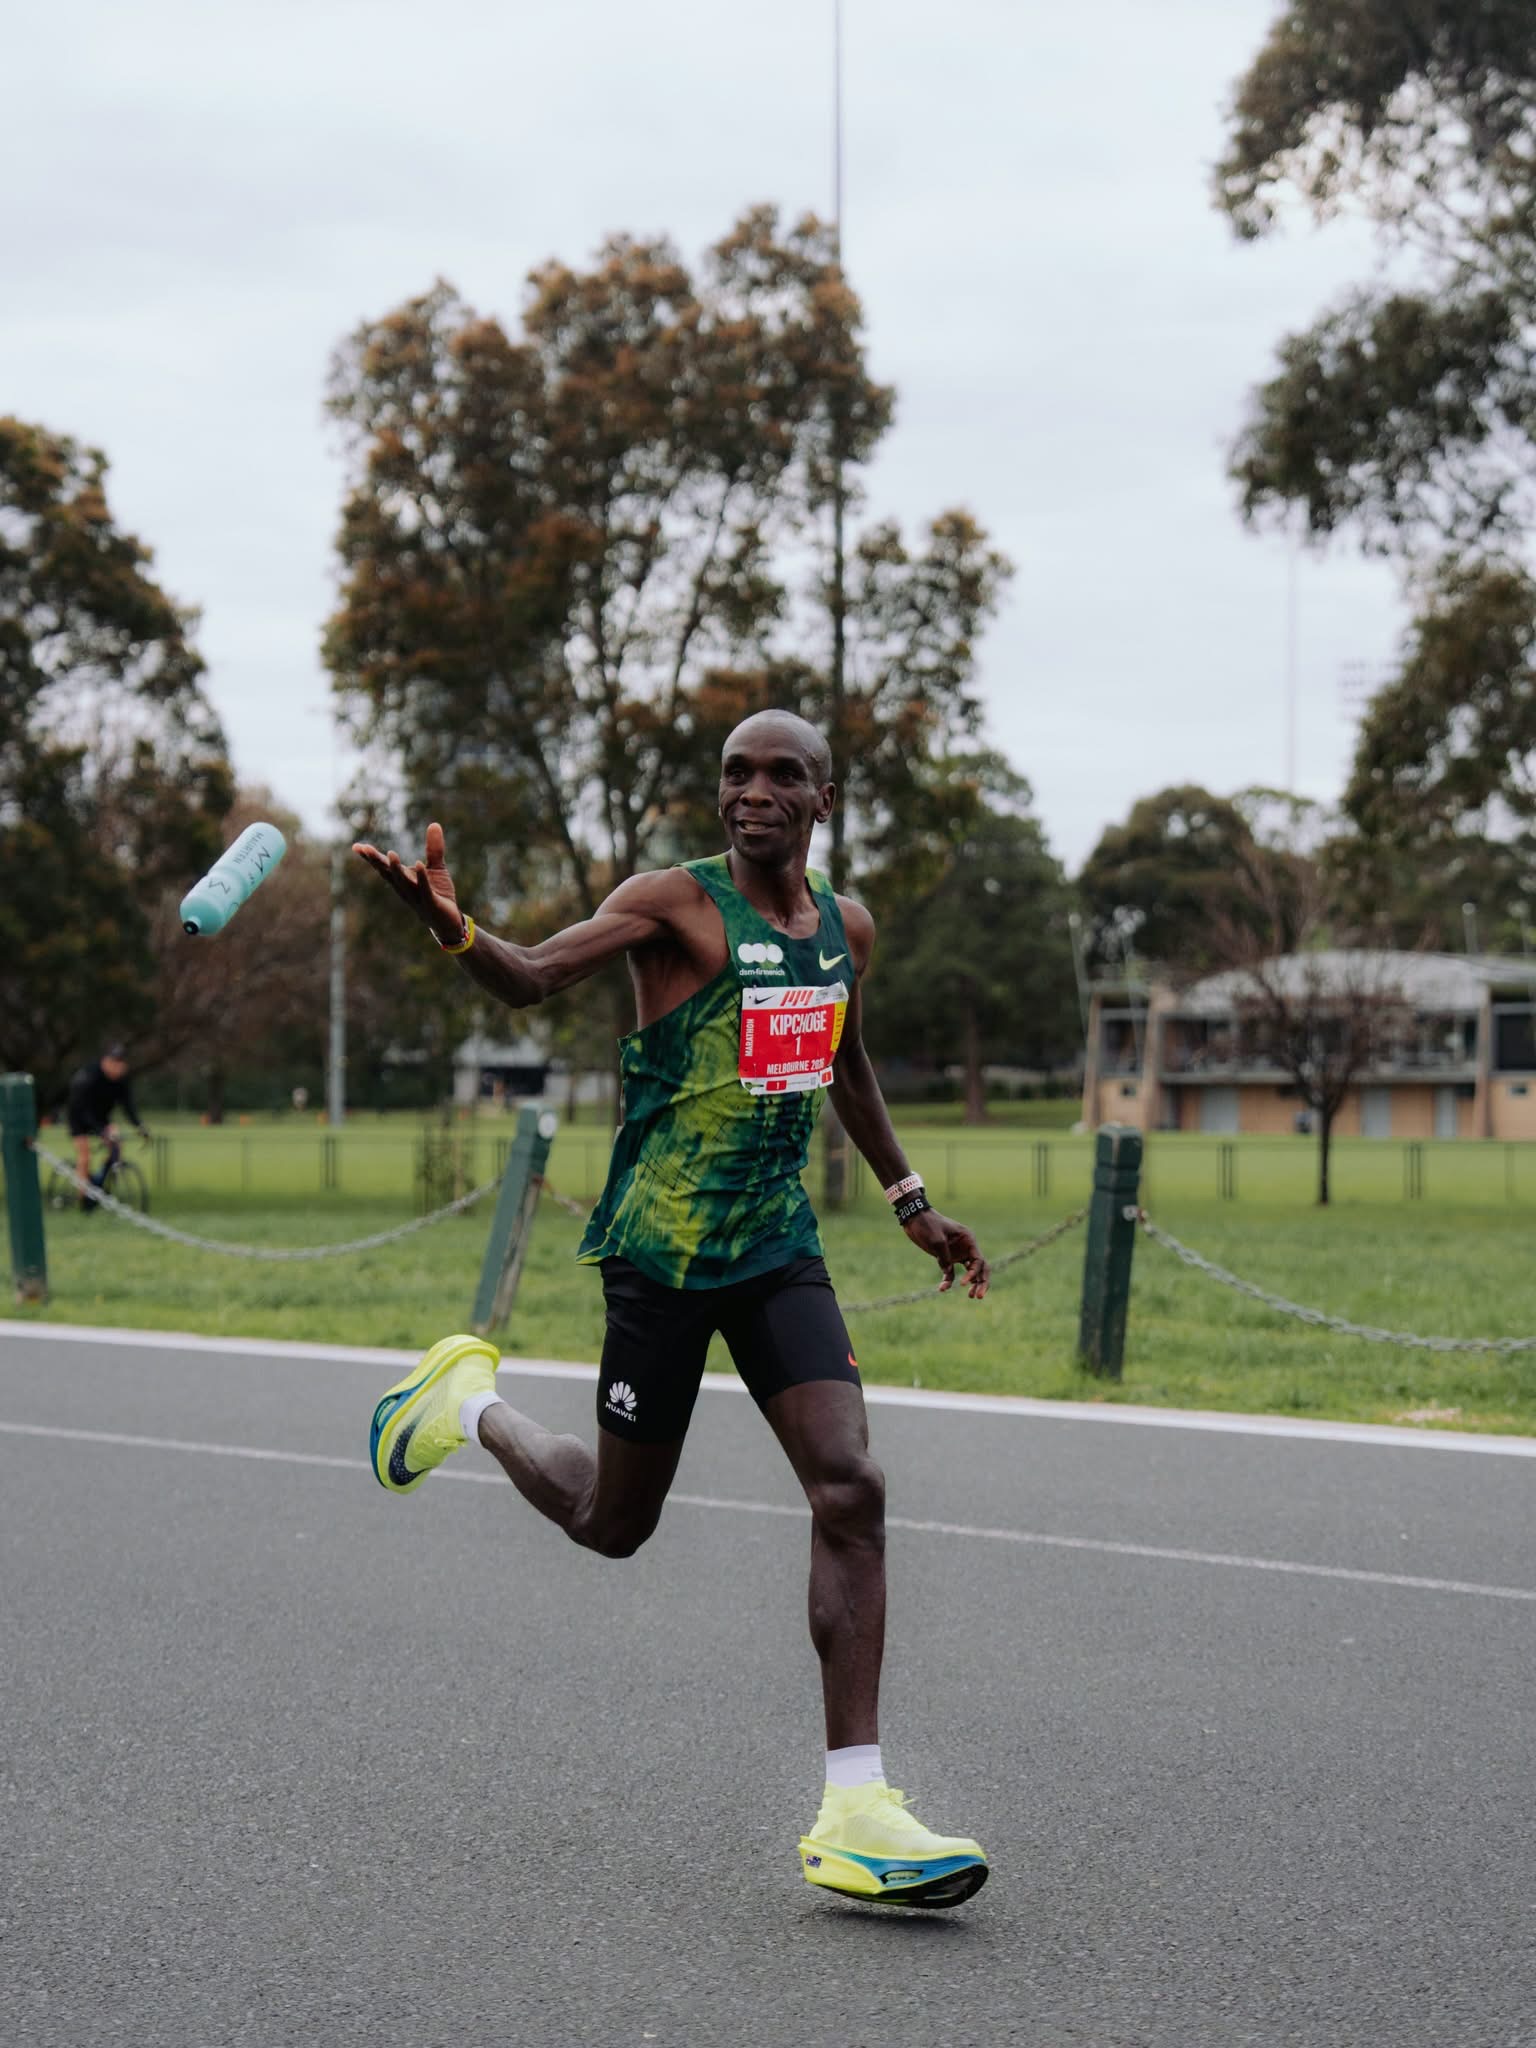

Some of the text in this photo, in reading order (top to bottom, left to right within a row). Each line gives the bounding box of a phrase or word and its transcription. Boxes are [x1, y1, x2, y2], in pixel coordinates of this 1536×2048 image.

[233, 831, 264, 864] MAURTEN
[769, 1010, 827, 1036] KIPCHOGE
[745, 1018, 754, 1057] MARATHON
[795, 1035, 802, 1056] 1
[766, 1060, 809, 1075] MELBOURNE
[605, 1401, 636, 1422] HUAWEI
